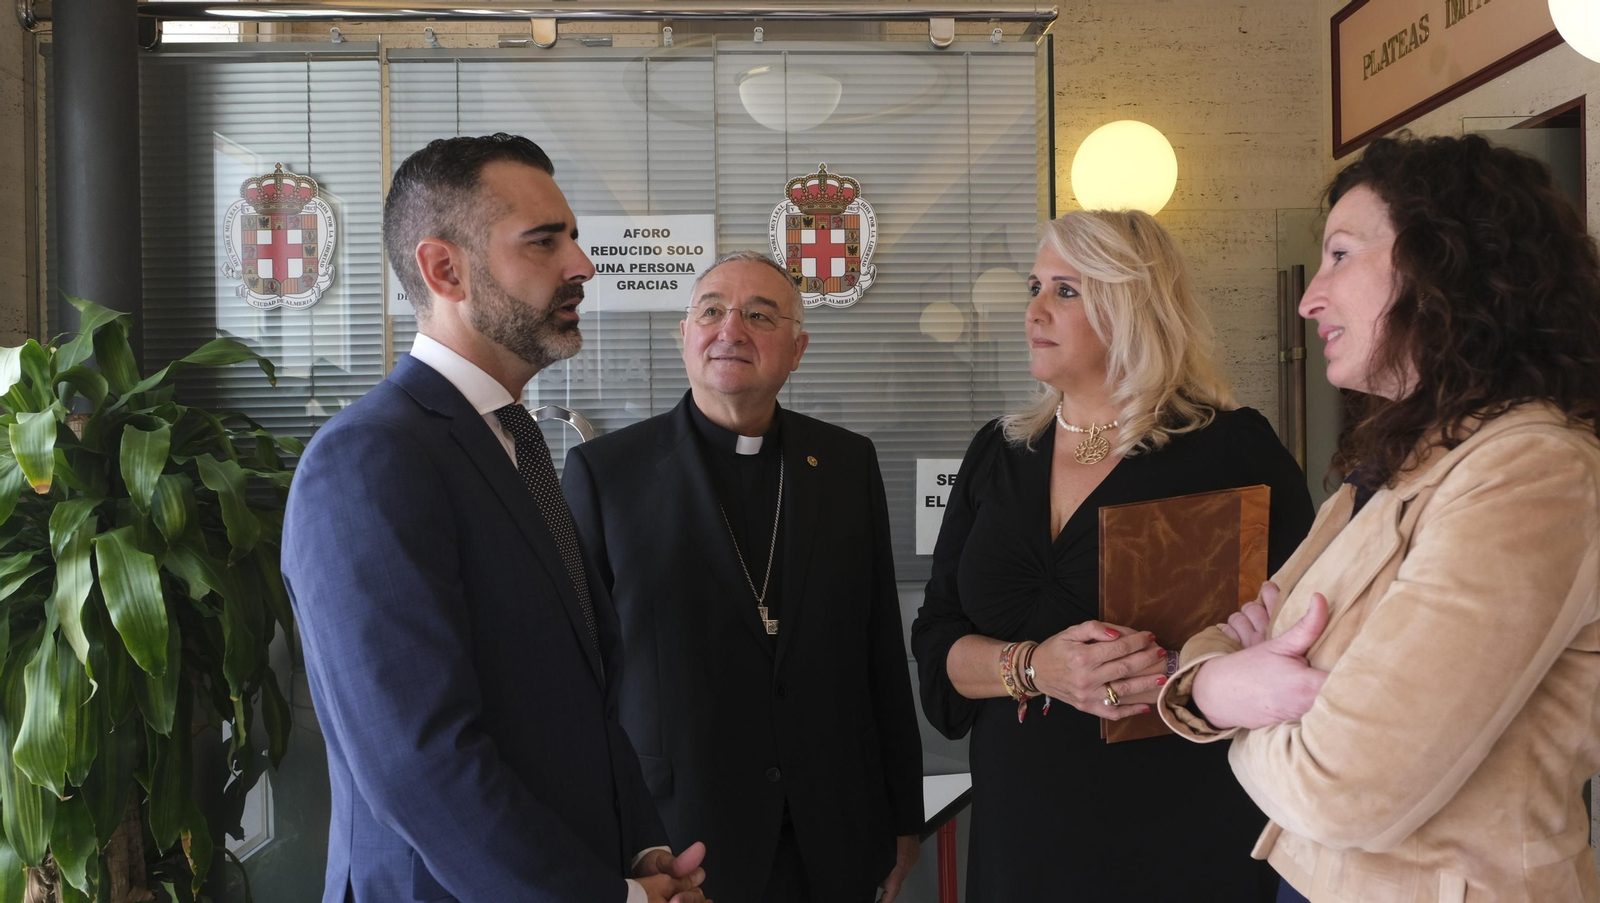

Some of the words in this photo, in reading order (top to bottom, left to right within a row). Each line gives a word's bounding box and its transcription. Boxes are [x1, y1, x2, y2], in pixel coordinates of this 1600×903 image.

[1363, 13, 1429, 81] PLATEAS
[329, 230, 334, 238] LA
[623, 228, 671, 239] AFORO
[870, 230, 876, 238] LA
[320, 240, 332, 268] LIBERTAD
[590, 246, 663, 256] REDUCIDO
[666, 245, 704, 256] SOLO
[861, 240, 874, 268] LIBERTAD
[595, 263, 626, 273] UNA
[629, 263, 696, 273] PERSONA
[616, 280, 679, 290] GRACIAS
[252, 299, 276, 307] CIUDAD
[285, 298, 313, 306] ALMERIA
[925, 495, 946, 508] EL
